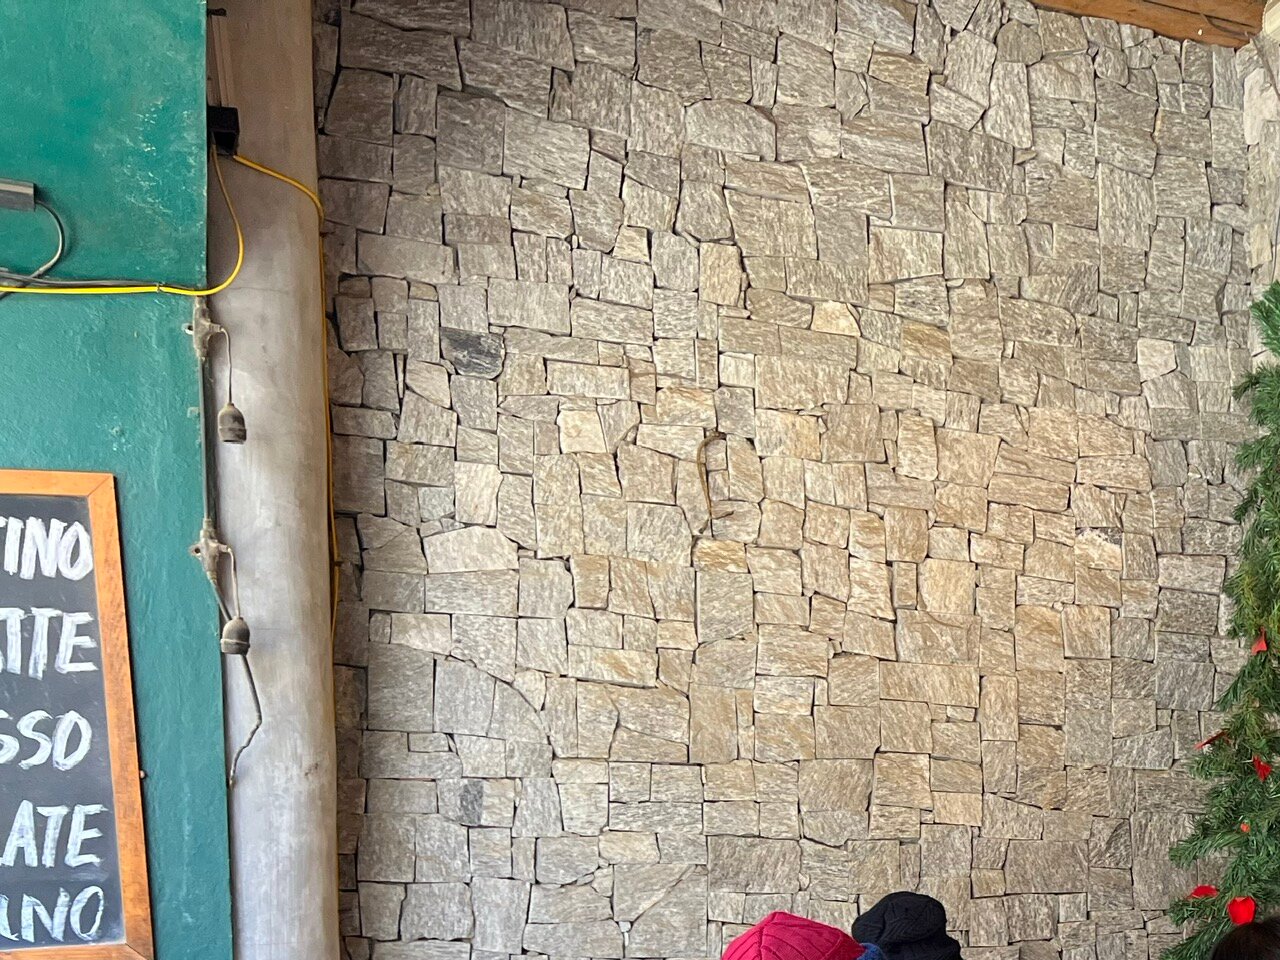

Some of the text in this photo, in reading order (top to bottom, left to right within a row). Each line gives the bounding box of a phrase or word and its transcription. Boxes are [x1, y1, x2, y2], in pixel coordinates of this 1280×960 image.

[0, 516, 94, 581] INO
[0, 606, 99, 681] TTE
[0, 799, 109, 868] ATE
